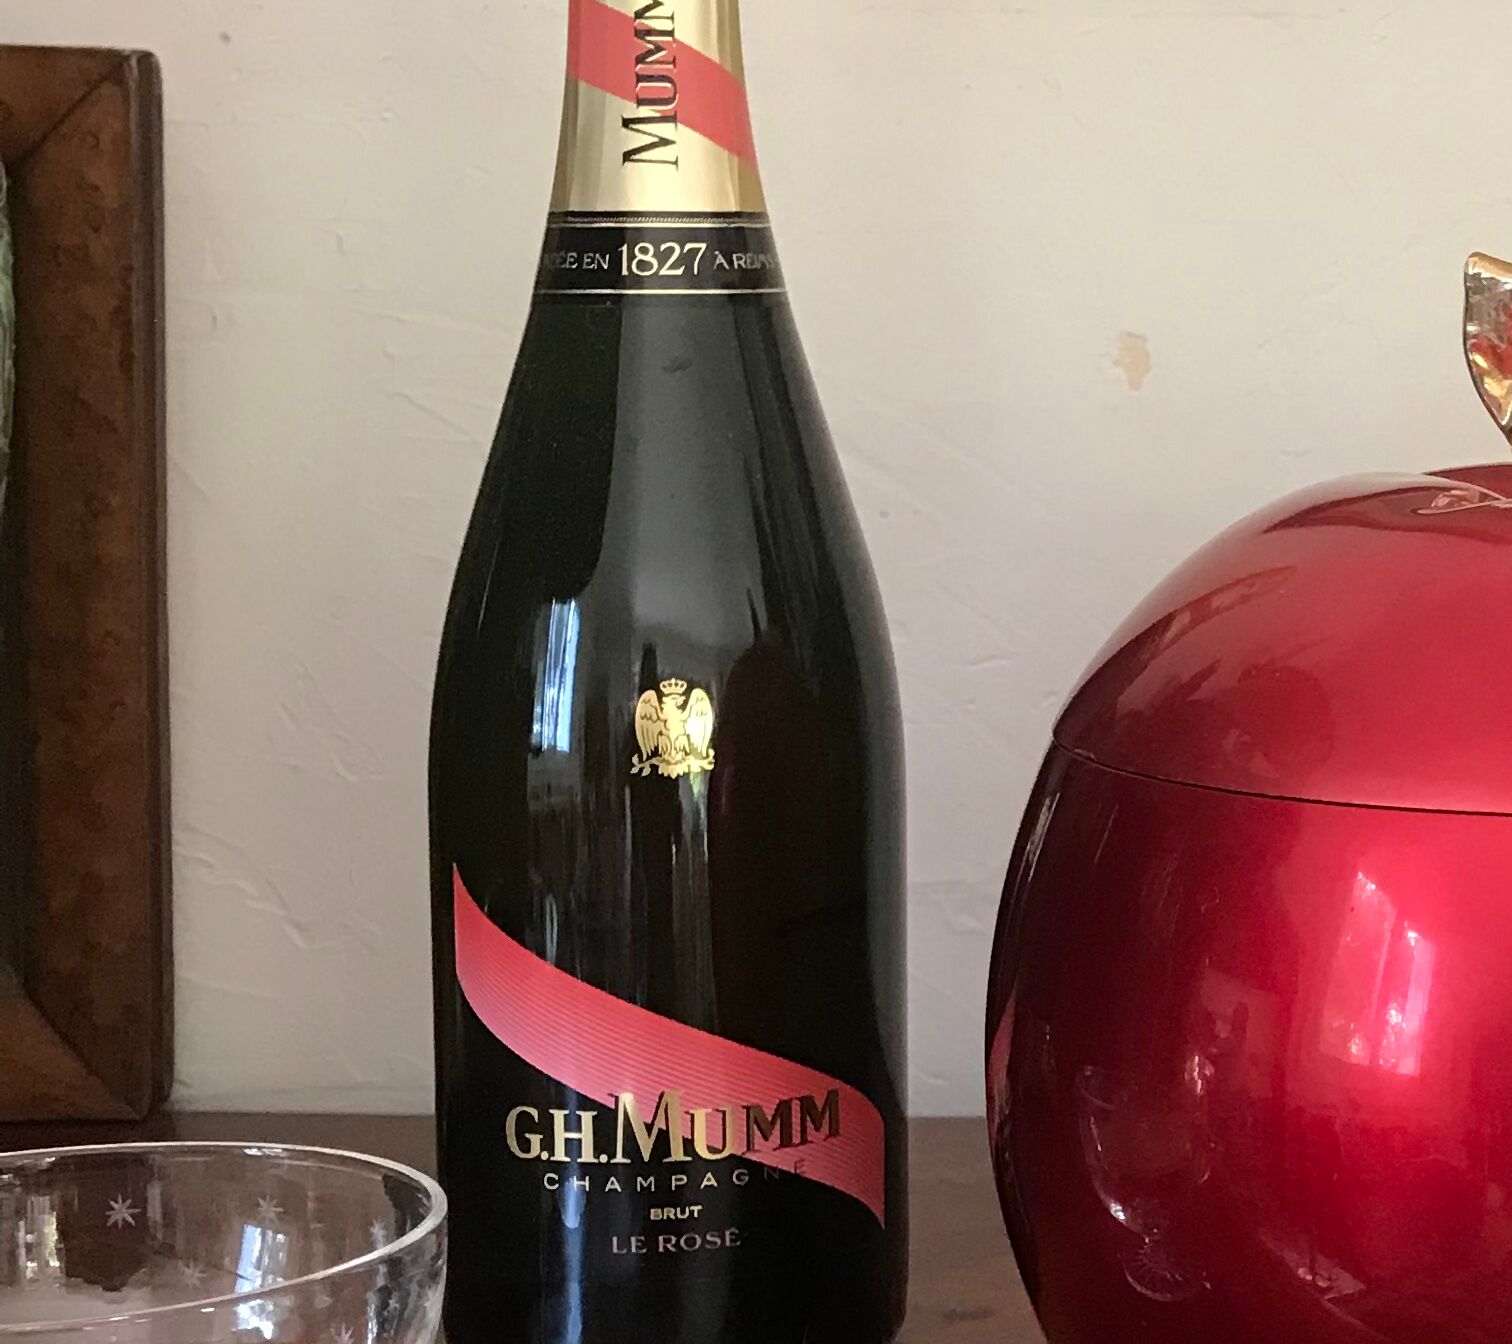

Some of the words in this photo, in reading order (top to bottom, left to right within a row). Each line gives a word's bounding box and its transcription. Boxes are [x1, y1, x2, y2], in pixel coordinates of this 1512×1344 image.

[582, 252, 610, 270] EN
[617, 242, 707, 277] 1827
[650, 1205, 703, 1221] BRUT
[612, 1234, 647, 1255] LE
[657, 1226, 742, 1255] ROSÉ
